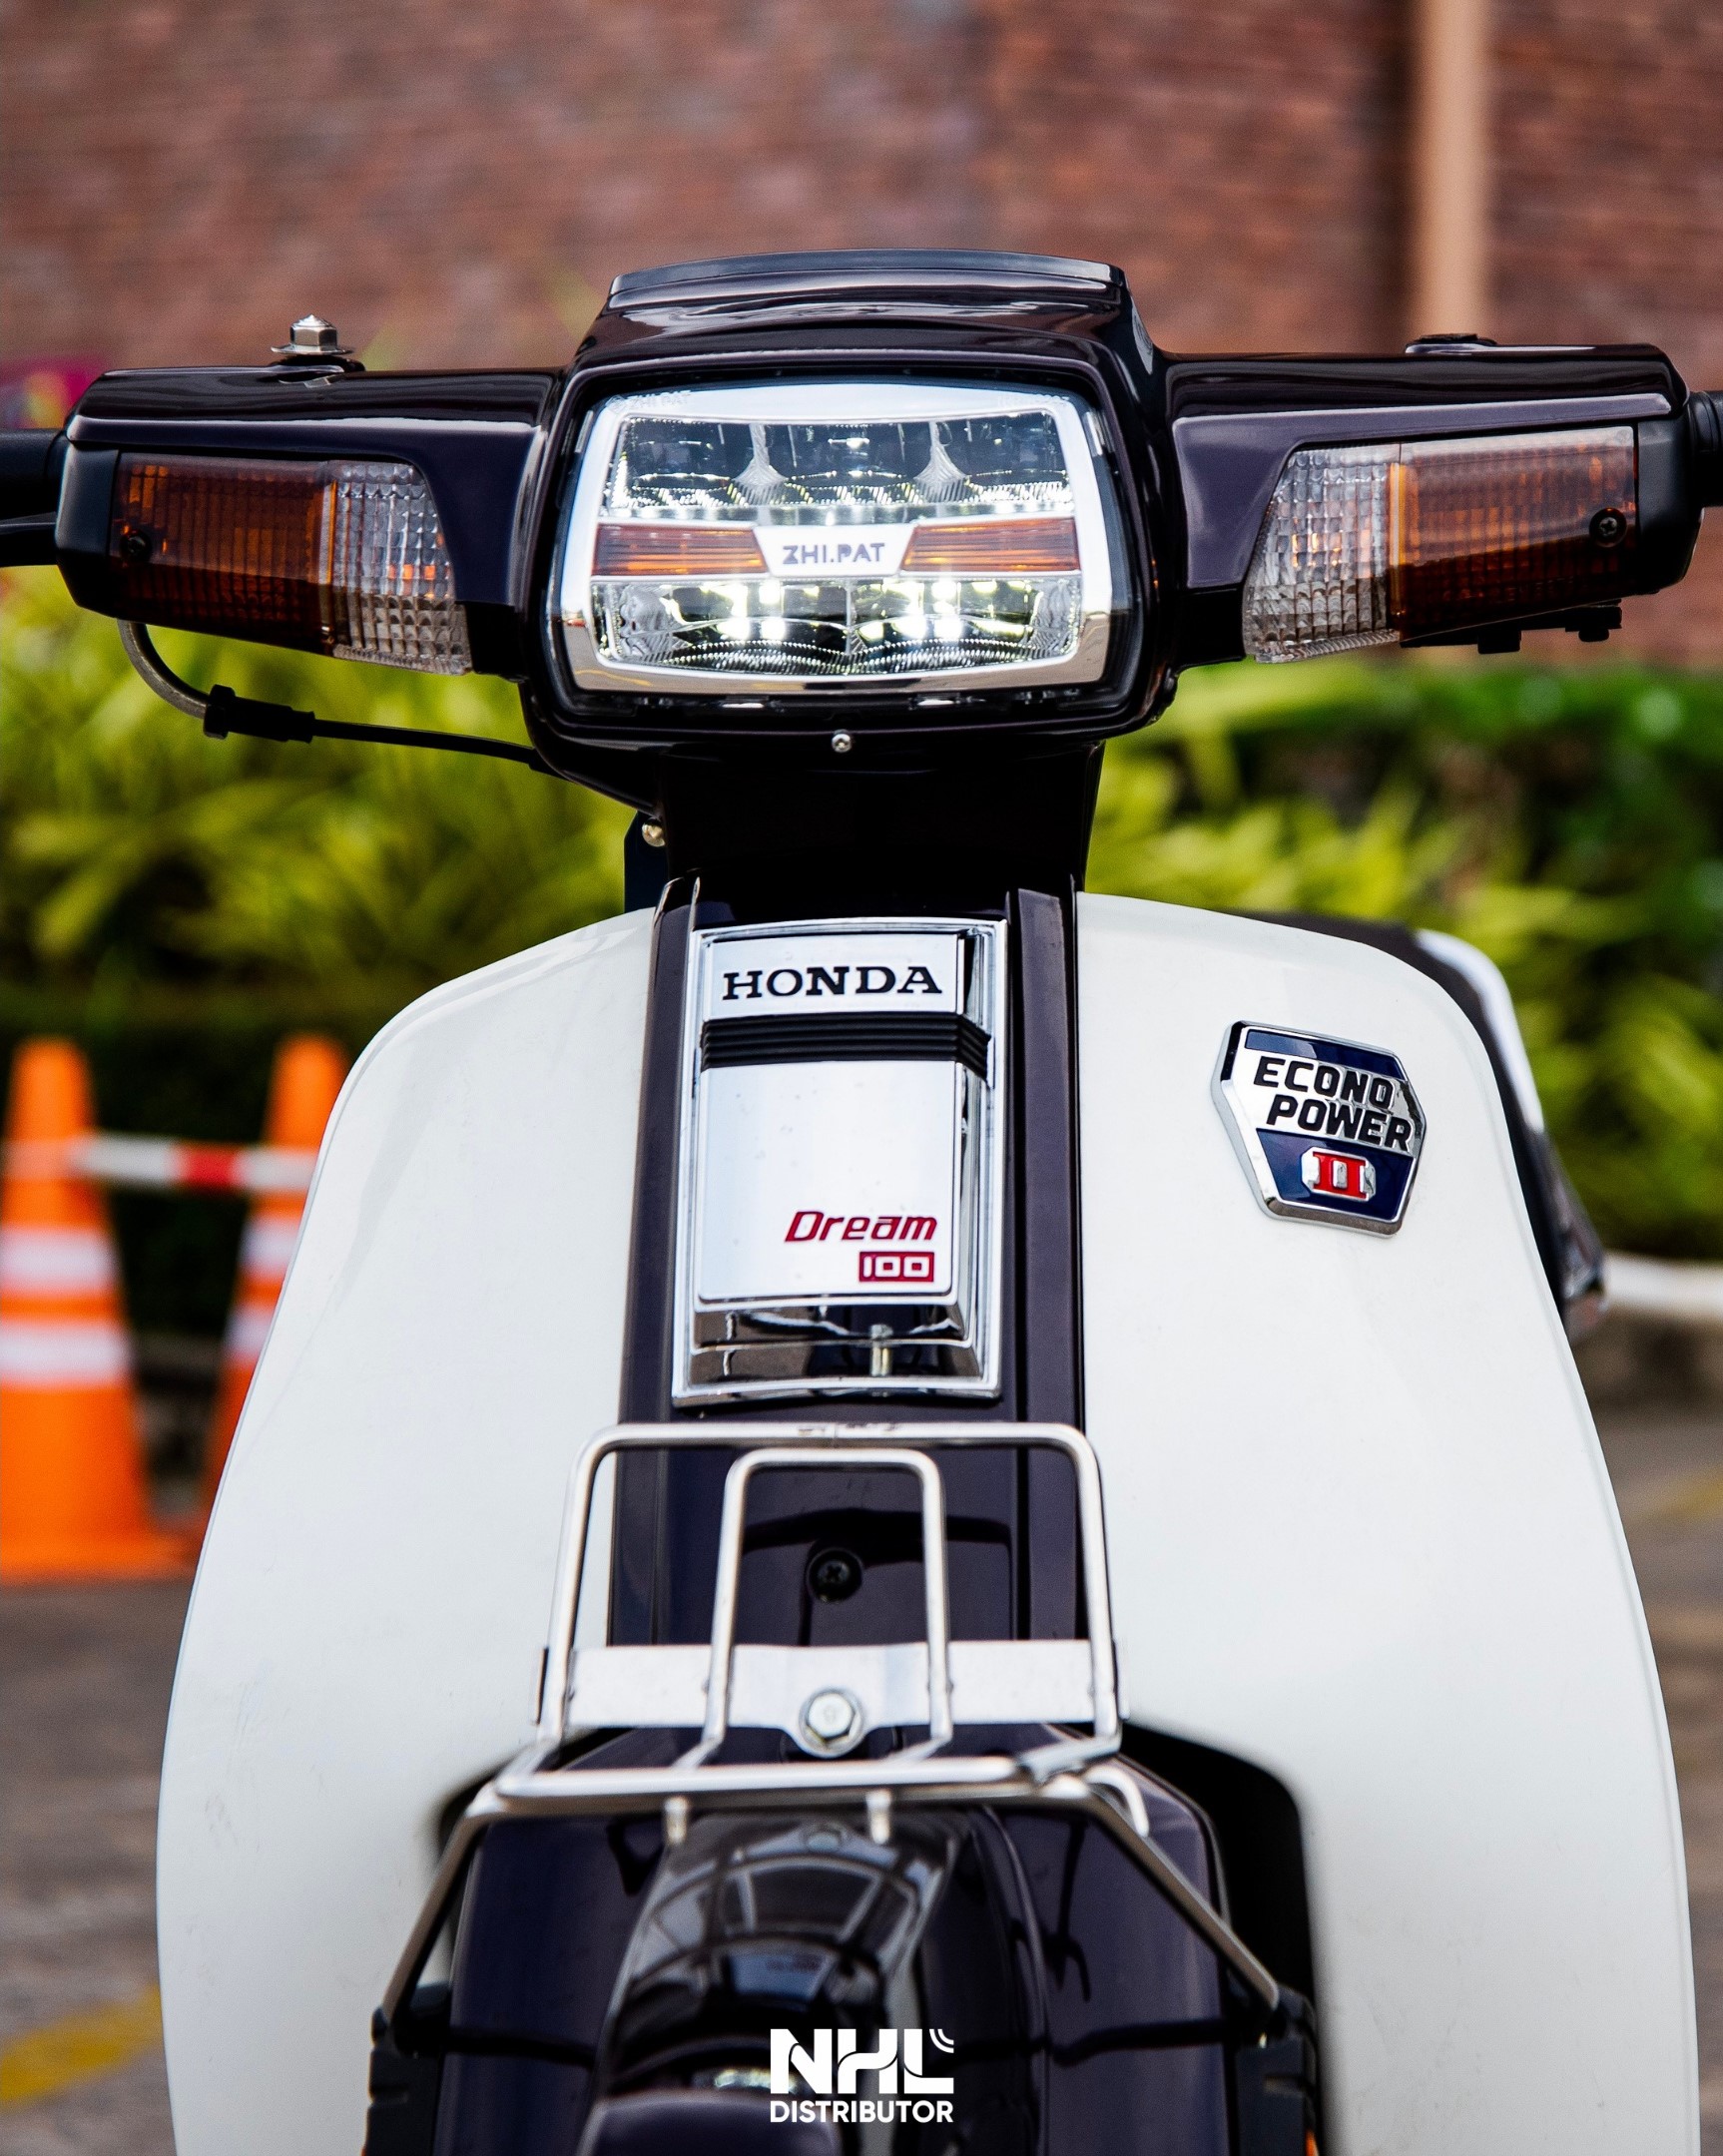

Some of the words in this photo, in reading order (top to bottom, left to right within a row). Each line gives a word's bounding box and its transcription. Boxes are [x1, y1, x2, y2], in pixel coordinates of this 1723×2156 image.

[782, 542, 885, 565] ZHI.PAT
[722, 965, 943, 1000] HONDA
[1253, 1055, 1394, 1110] ECONO
[1266, 1093, 1413, 1152] POWER
[785, 1210, 938, 1243] Dream
[862, 1254, 931, 1280] 100
